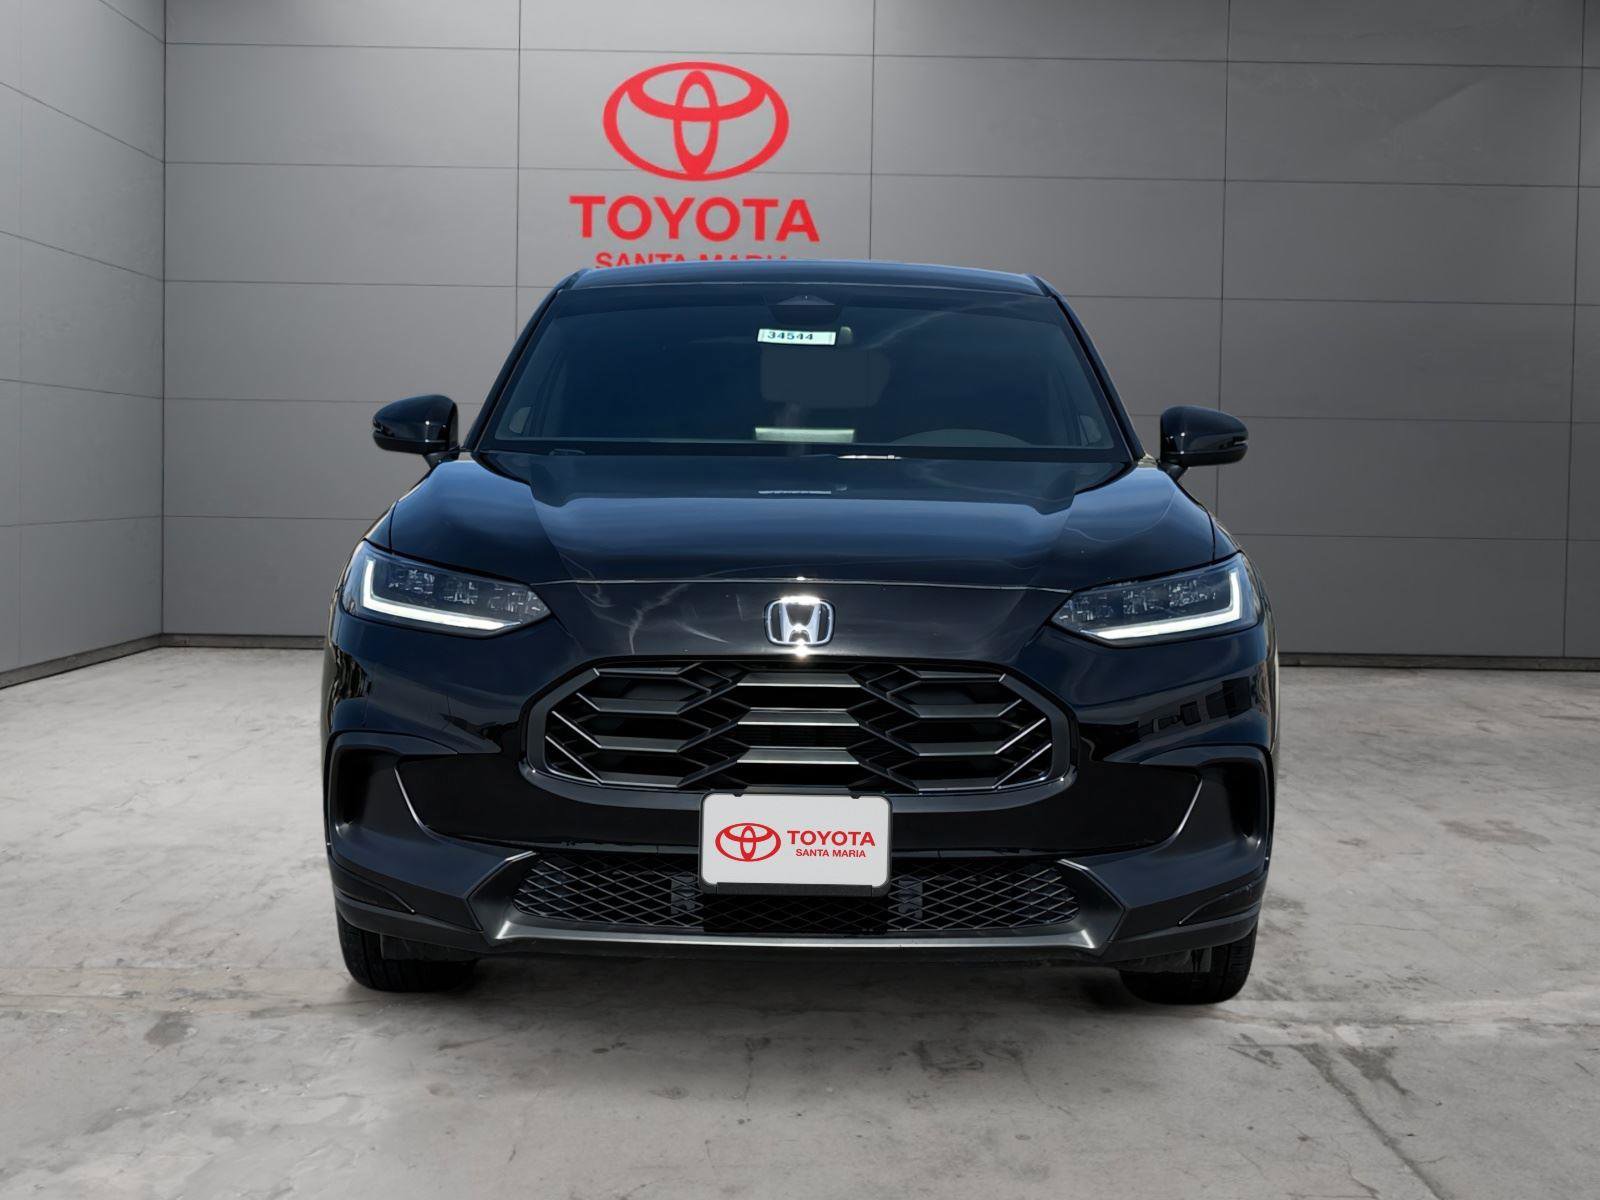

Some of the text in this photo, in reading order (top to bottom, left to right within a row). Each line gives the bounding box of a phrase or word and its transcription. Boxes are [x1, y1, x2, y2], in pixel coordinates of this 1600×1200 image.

[569, 195, 820, 242] TOYOTA
[767, 331, 814, 340] 34544
[787, 830, 875, 846] TOYOTA
[796, 849, 866, 858] SANTA MARIA
